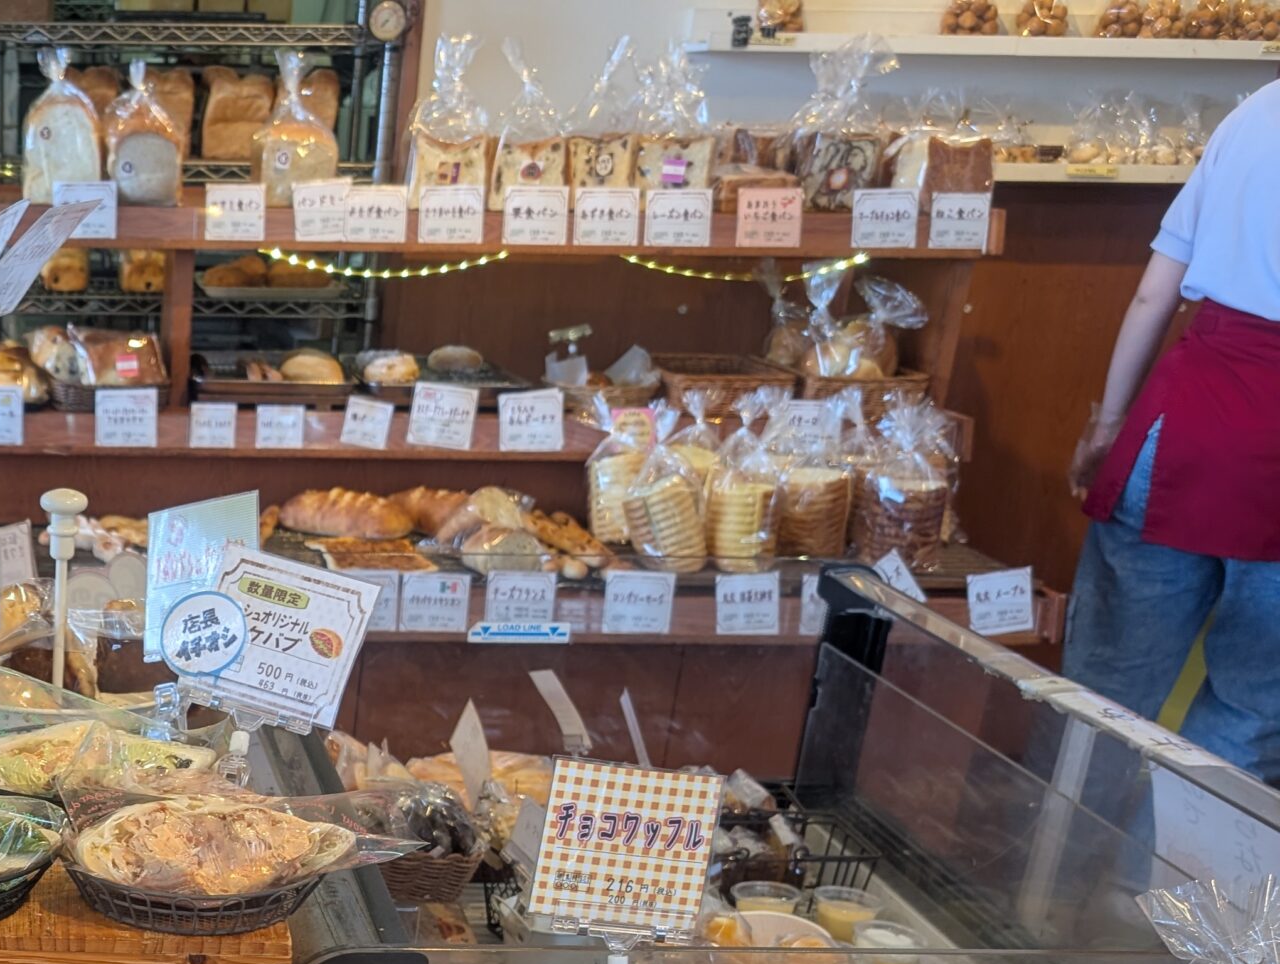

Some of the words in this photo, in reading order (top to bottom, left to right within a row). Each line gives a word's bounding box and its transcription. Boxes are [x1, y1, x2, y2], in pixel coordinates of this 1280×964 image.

[246, 580, 302, 607] 数量限定
[492, 586, 546, 602] チーズフランス
[182, 608, 221, 634] 店長
[497, 623, 520, 632] LOAD
[523, 623, 542, 632] LINE
[248, 625, 302, 653] ケバブ
[257, 662, 282, 680] 500
[258, 679, 275, 691] 463
[555, 802, 704, 851] チョコワッフル
[606, 877, 633, 894] 216
[607, 895, 626, 905] 200
